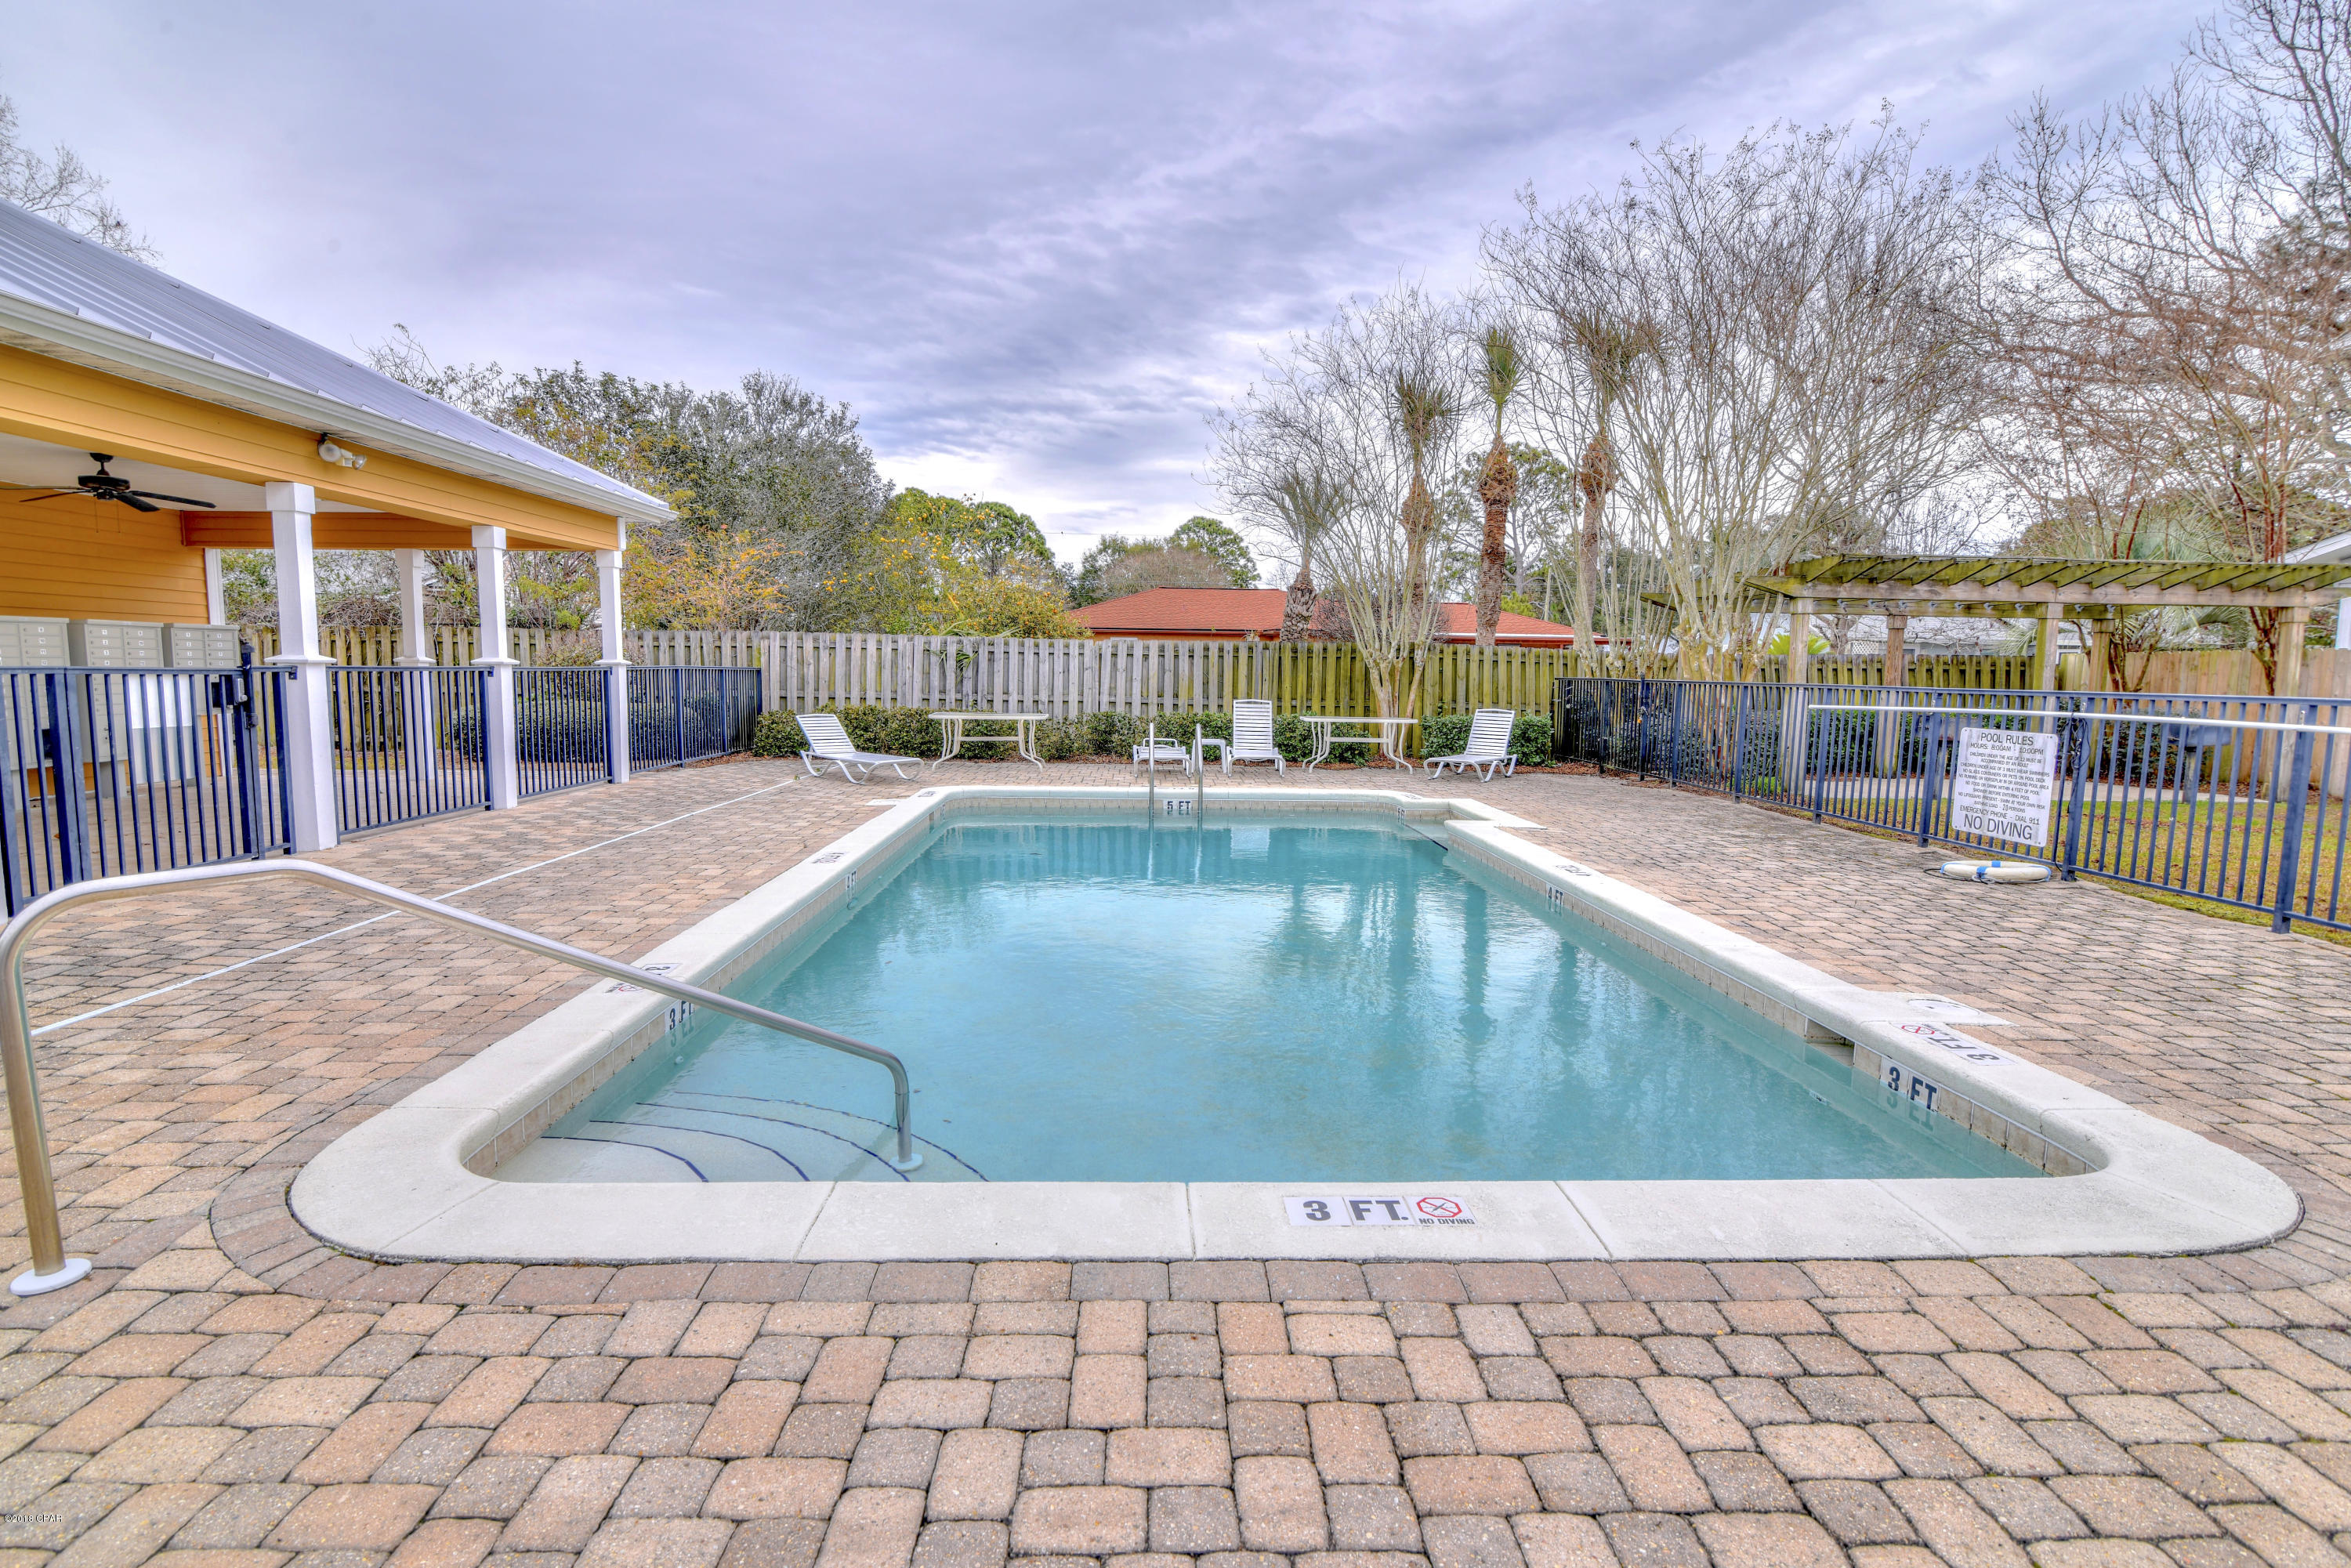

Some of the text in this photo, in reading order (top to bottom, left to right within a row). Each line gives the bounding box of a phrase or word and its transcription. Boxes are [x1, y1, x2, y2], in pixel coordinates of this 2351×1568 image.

[1981, 733, 2033, 746] POOL RULES
[1167, 801, 1191, 809] 5 FT
[1960, 805, 1989, 815] EMERGENCY
[1990, 811, 2008, 819] PHONE
[2015, 815, 2027, 823] DIAL
[2029, 817, 2039, 826] 911
[1964, 814, 2032, 840] NO DIVING
[1548, 886, 1563, 905] 4 FT
[669, 1008, 676, 1030] 3
[1887, 1066, 1937, 1110] 3 FT
[1302, 1200, 1409, 1222] 3 FT.
